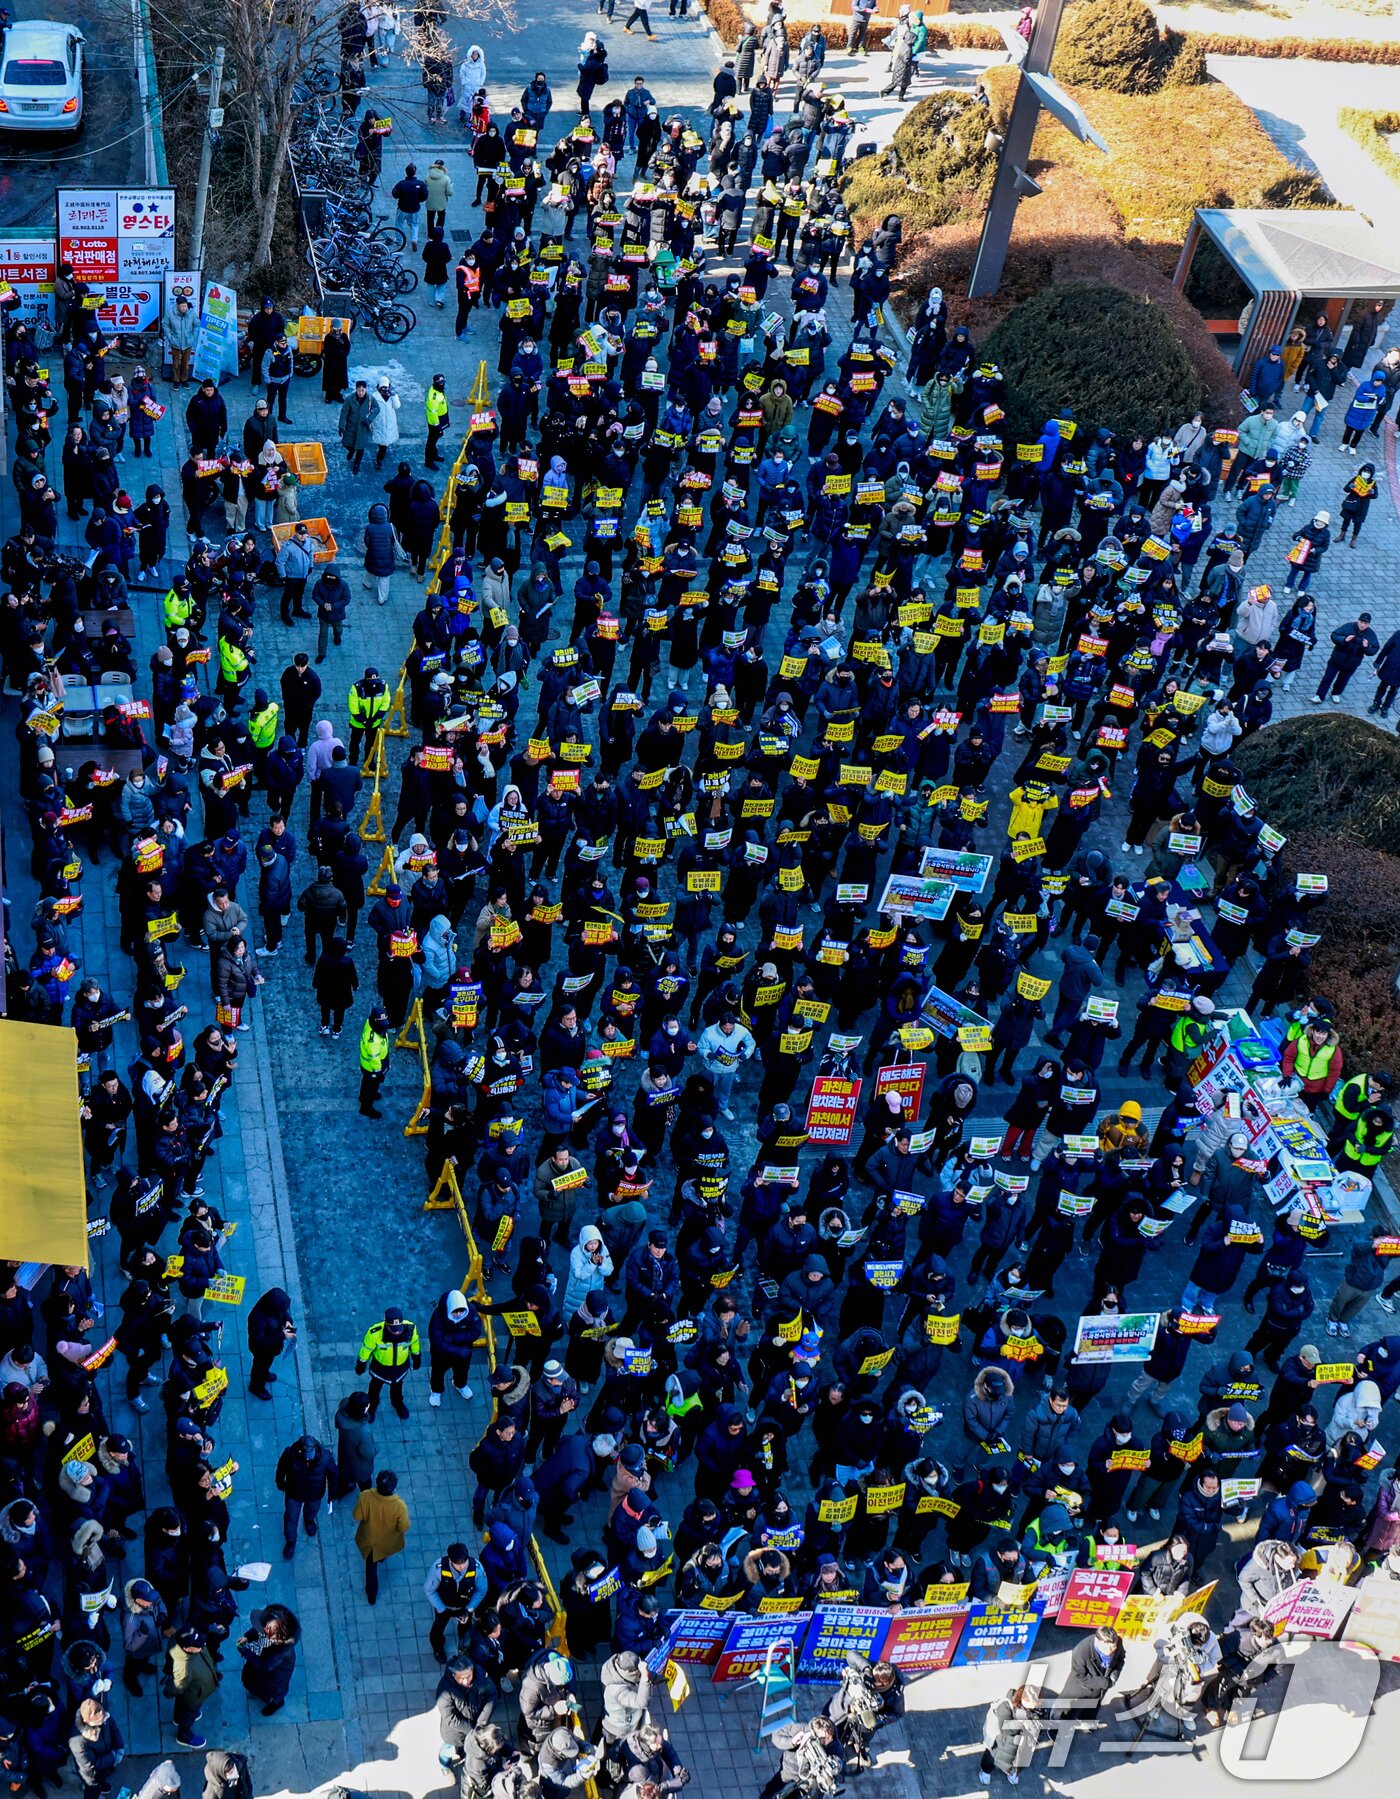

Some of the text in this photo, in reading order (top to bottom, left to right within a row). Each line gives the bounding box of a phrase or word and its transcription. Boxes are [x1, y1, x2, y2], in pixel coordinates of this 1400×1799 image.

[123, 216, 169, 230] 영스타
[63, 250, 116, 264] 복권판매점
[106, 286, 132, 299] 별양
[98, 304, 139, 326] 복싱
[826, 729, 854, 740] 이전반대
[714, 749, 744, 757] 이전반대
[841, 773, 872, 784] 이전반대
[635, 844, 665, 854] 이전반대
[880, 1068, 922, 1082] 해도해도
[822, 1081, 852, 1093] 과천을
[878, 1081, 920, 1094] 너무한다
[812, 1095, 856, 1108] 망치려는 자
[810, 1112, 850, 1126] 과천에서
[868, 1494, 904, 1507] 이전반대
[918, 1502, 957, 1516] 이전반대
[1074, 1571, 1120, 1586] 절대
[1078, 1586, 1124, 1599] 사수
[1065, 1599, 1112, 1614] 전면
[824, 1614, 879, 1626] 현장무시
[1007, 1613, 1038, 1624] 위로
[1070, 1612, 1114, 1627] 철회
[741, 1626, 797, 1638] 경마산업
[820, 1626, 878, 1638] 고객무시
[897, 1630, 953, 1642] 무시하는
[974, 1624, 1028, 1636] 아파트가
[816, 1637, 872, 1649] 경마공원
[673, 1648, 708, 1658] UT!
